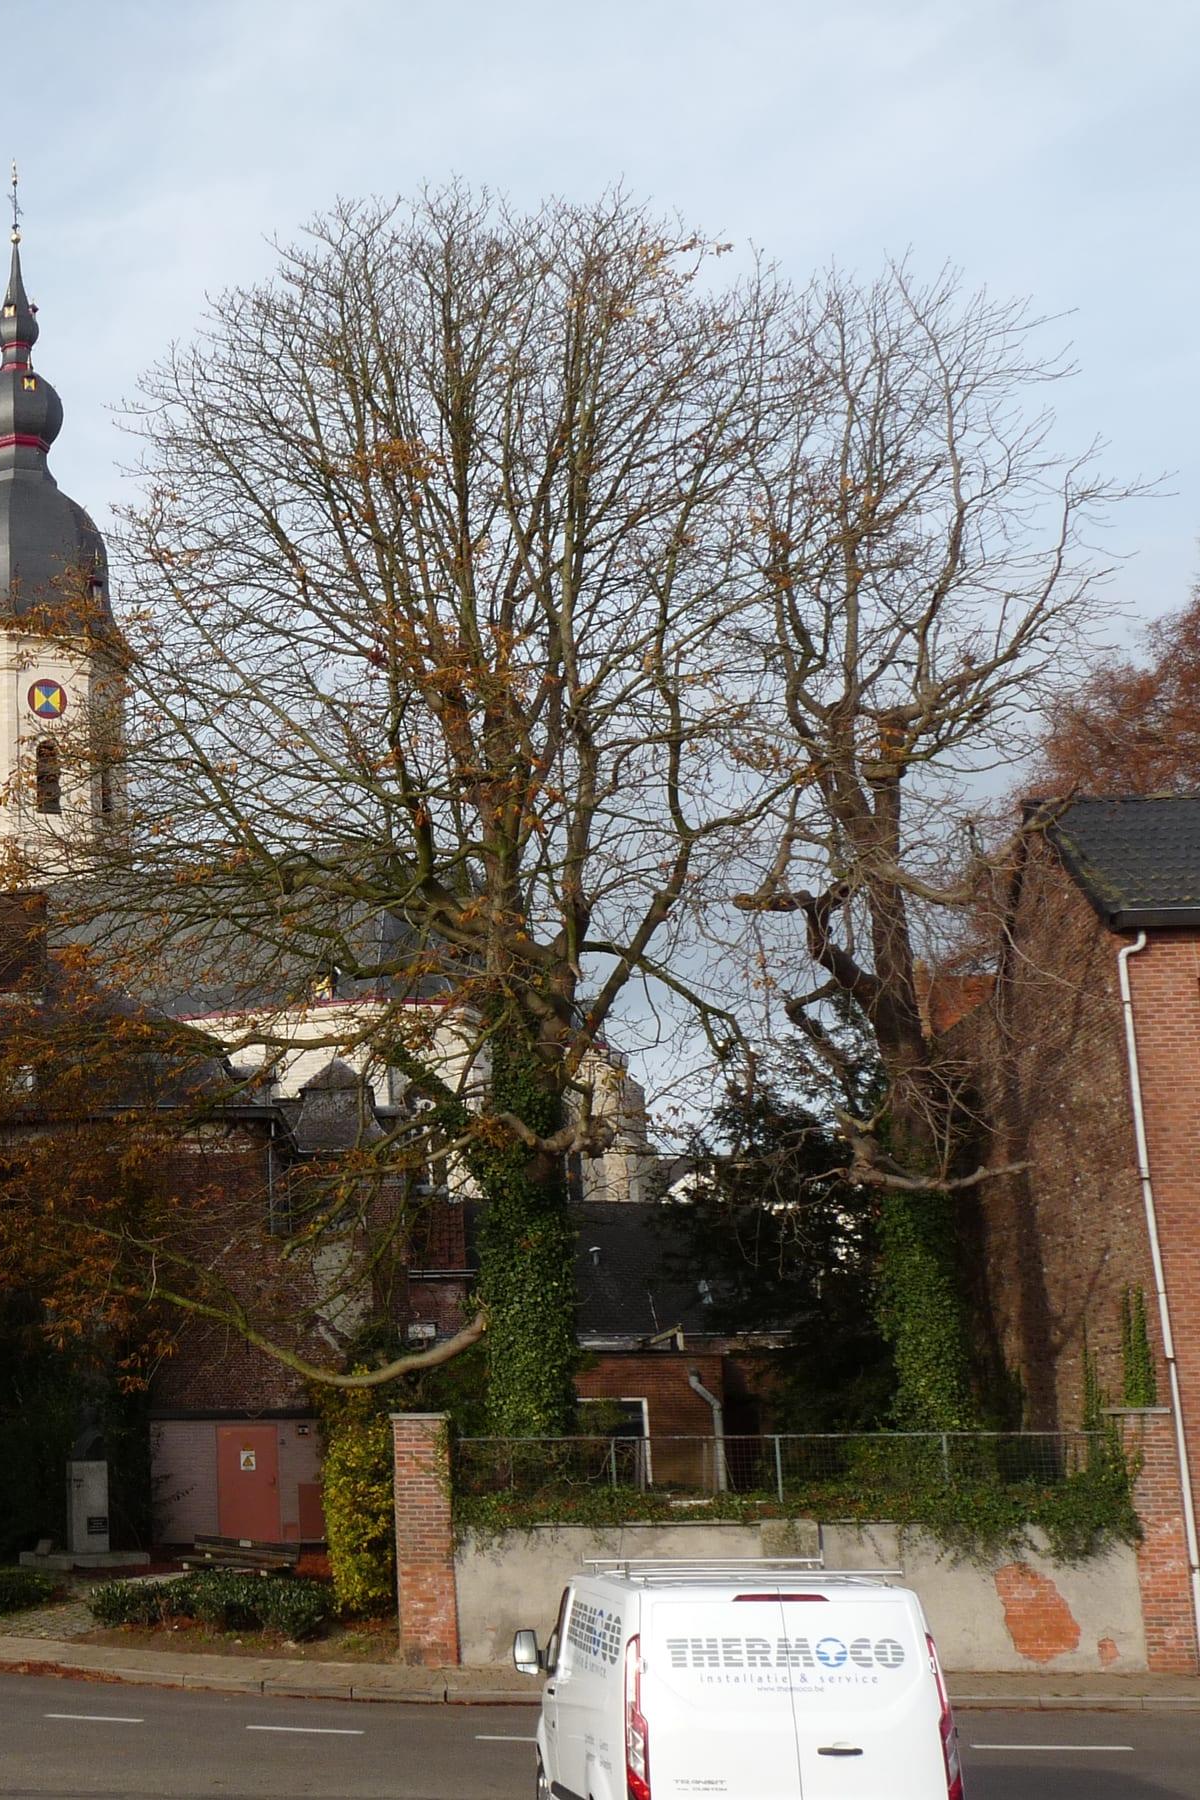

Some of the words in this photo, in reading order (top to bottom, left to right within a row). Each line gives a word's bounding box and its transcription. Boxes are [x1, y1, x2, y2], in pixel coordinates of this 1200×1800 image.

[666, 1637, 905, 1668] THERMOCO
[700, 1673, 788, 1684] installatie
[800, 1673, 809, 1684] &
[819, 1673, 879, 1684] service
